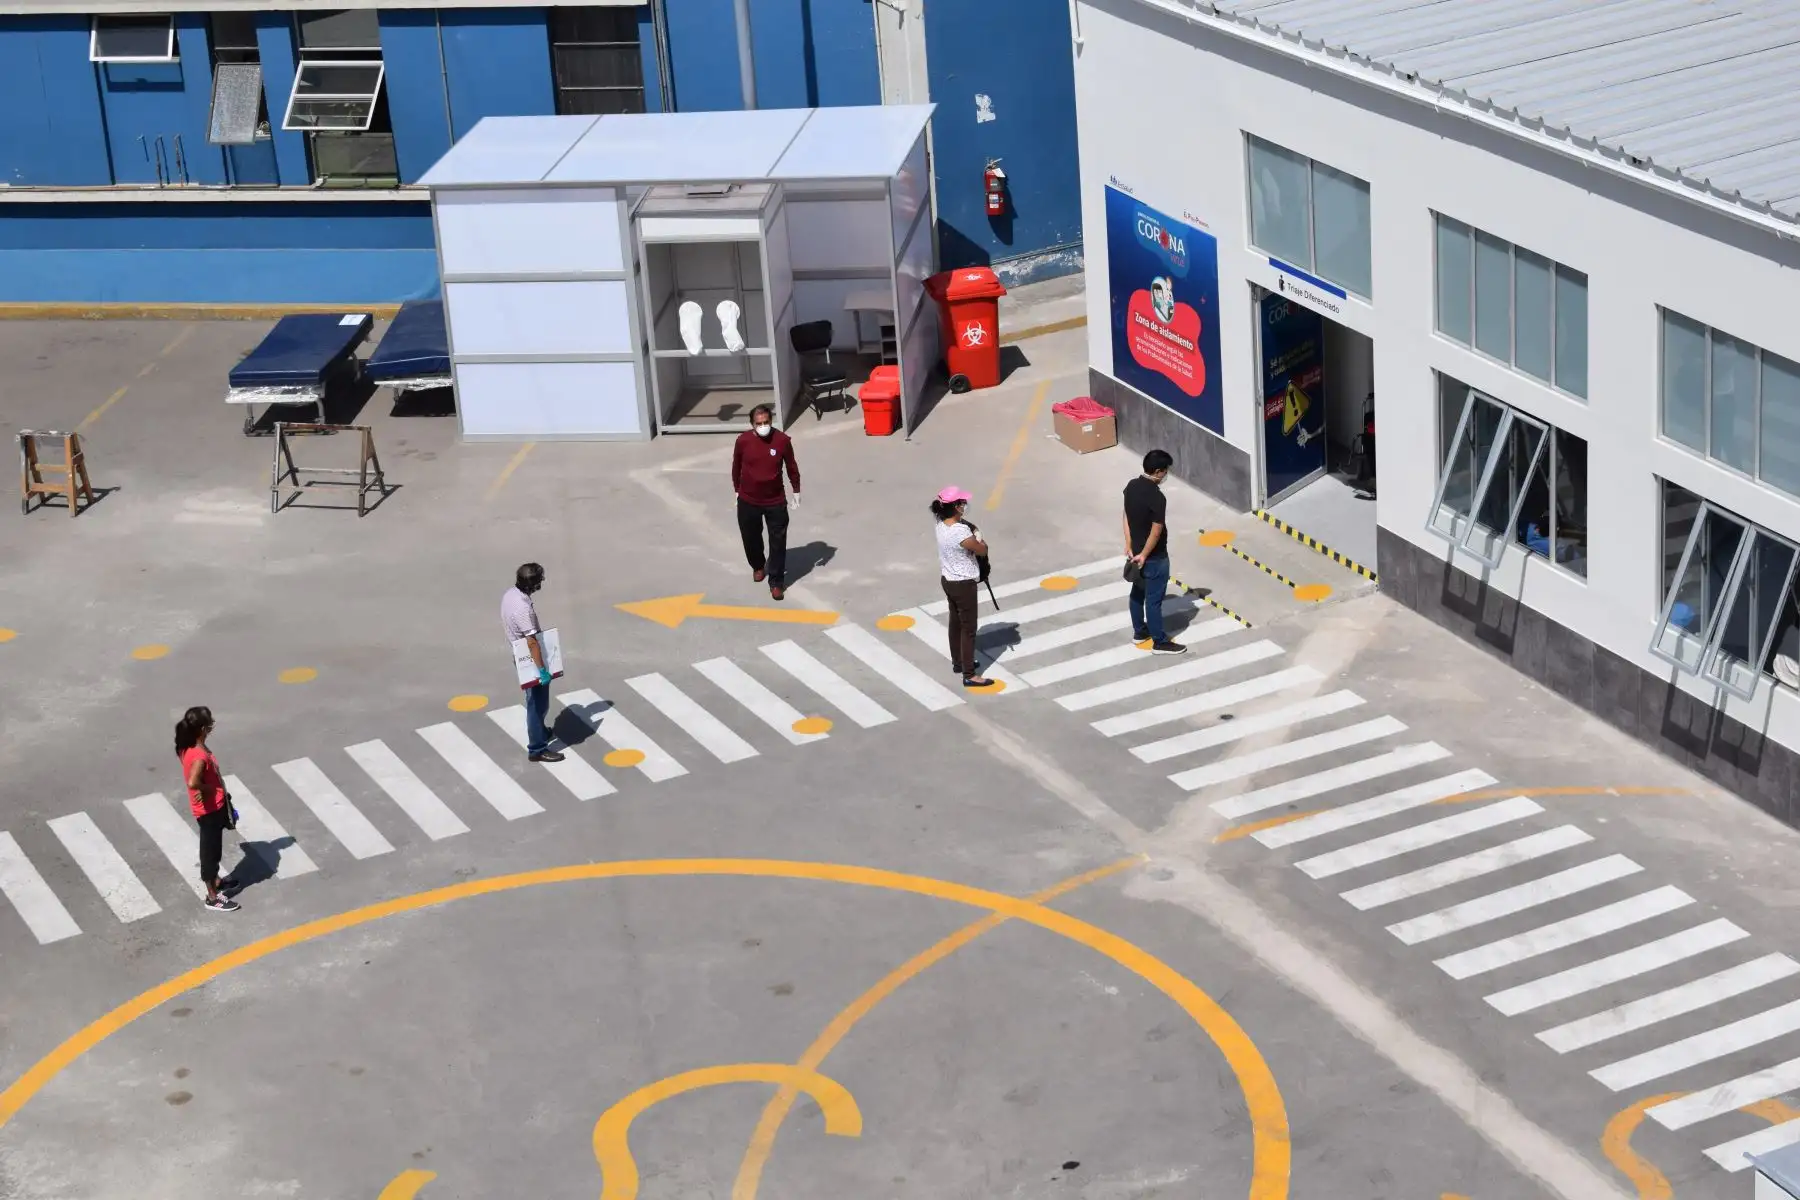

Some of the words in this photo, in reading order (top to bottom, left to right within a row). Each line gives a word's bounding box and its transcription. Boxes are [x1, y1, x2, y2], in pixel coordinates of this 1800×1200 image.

[1137, 219, 1186, 256] CORONA
[1287, 283, 1303, 297] Triaje
[1304, 290, 1340, 314] Diferenciado
[1135, 312, 1149, 328] Zona
[1151, 321, 1158, 332] de
[1159, 326, 1194, 351] aislamiento
